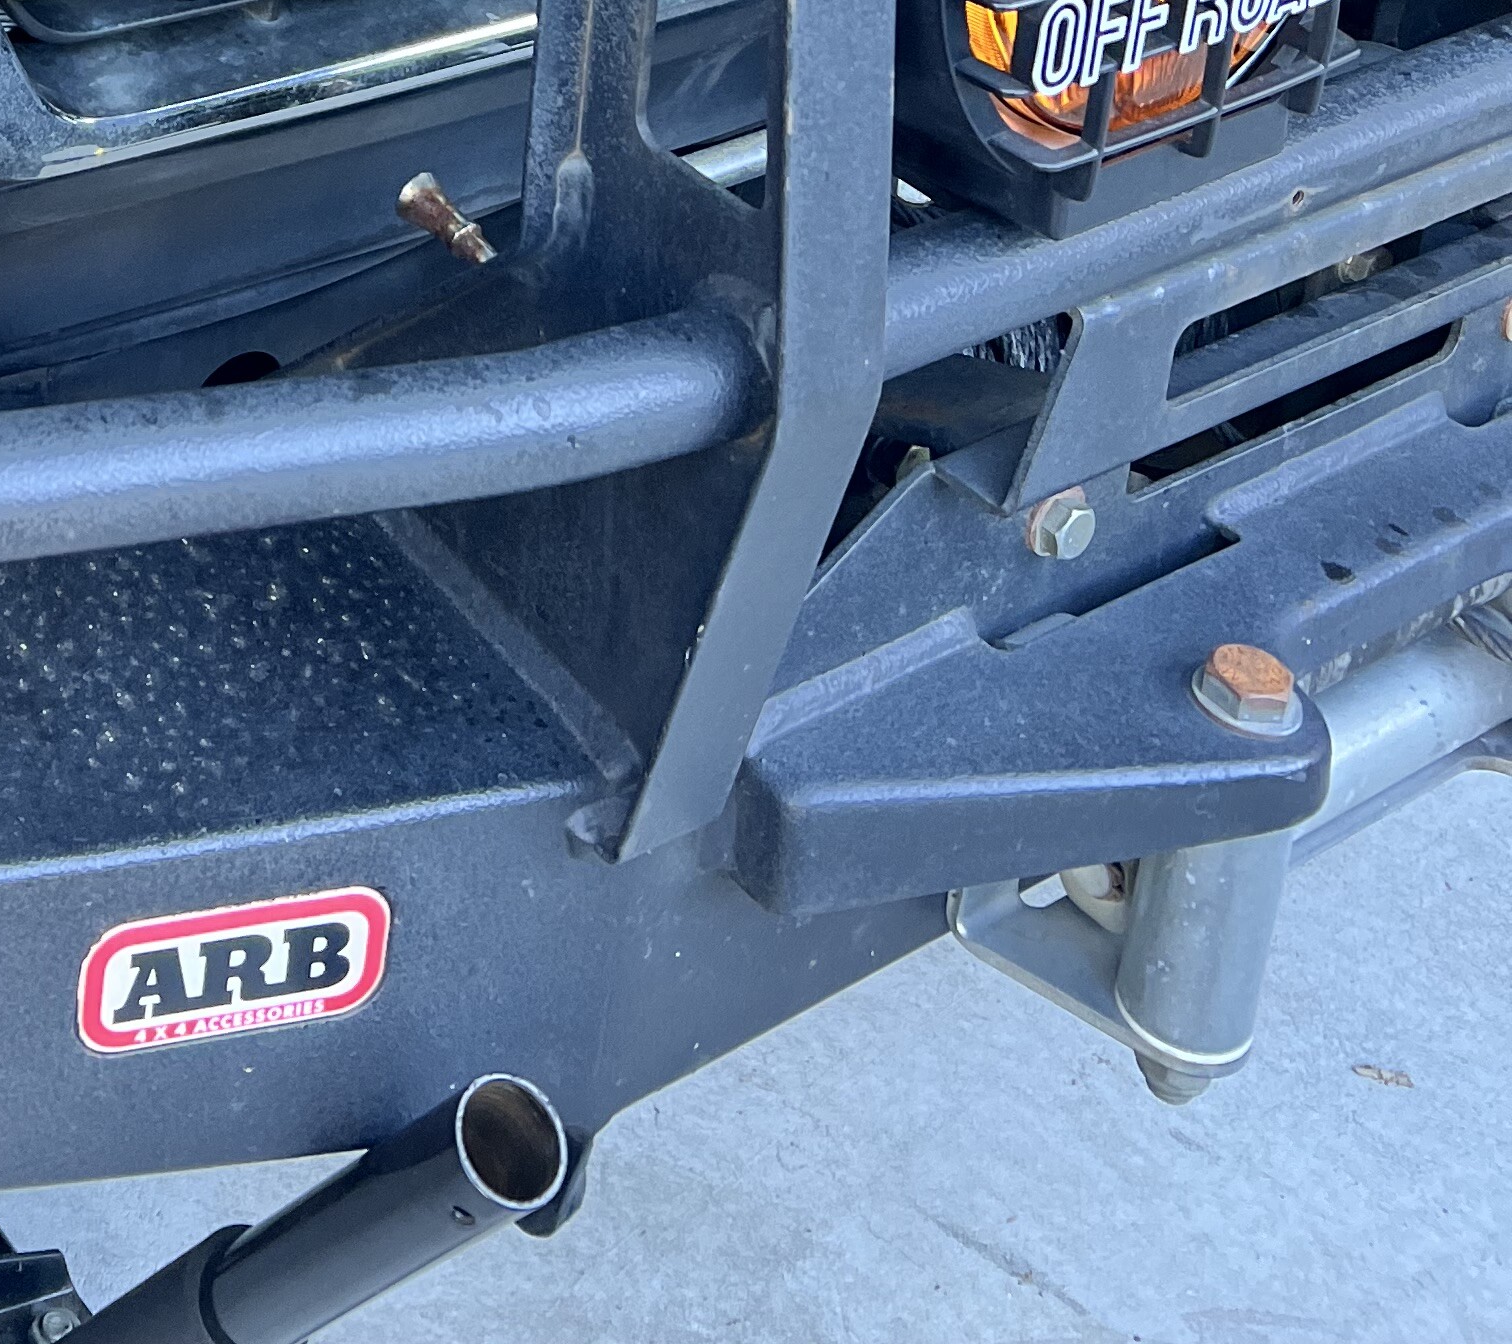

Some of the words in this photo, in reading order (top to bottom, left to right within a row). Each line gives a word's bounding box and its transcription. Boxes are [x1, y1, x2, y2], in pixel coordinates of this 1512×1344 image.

[113, 921, 351, 1025] ARB
[134, 1029, 147, 1043] 4
[174, 1022, 187, 1036] 4
[193, 998, 326, 1034] ACCESSORIES
